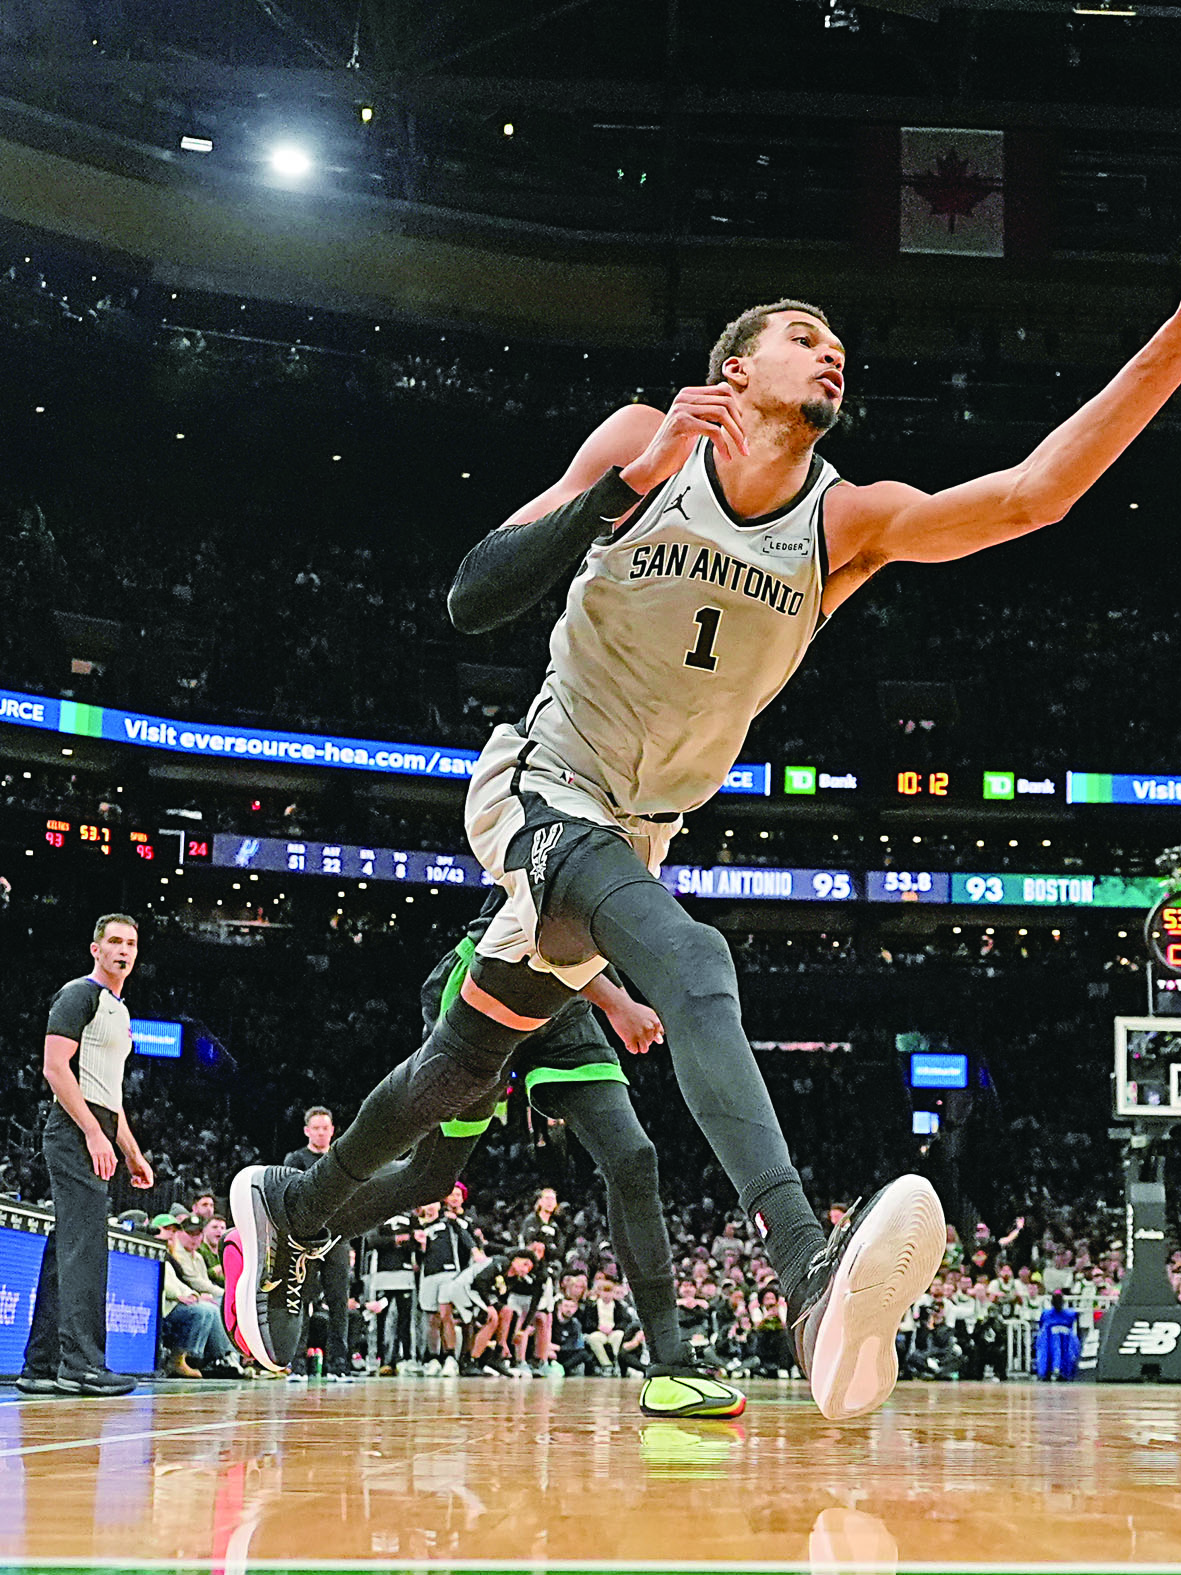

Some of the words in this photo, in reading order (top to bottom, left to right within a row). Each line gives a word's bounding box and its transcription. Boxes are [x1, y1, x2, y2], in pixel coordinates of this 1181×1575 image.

[769, 540, 804, 552] LEDGER
[629, 543, 690, 580] SAN
[688, 546, 805, 617] ANTONIO
[683, 605, 723, 673] 1
[124, 718, 177, 746] Visit
[179, 731, 479, 775] eversource-hea.com/sav
[722, 771, 753, 788] CE
[789, 771, 813, 789] TD
[819, 773, 857, 789] Bank
[897, 771, 949, 796] 10:12
[987, 775, 1011, 795] TD
[1017, 778, 1055, 794] Bank
[45, 832, 65, 848] 93
[188, 841, 208, 857] 24
[136, 845, 154, 860] 95
[288, 855, 304, 870] 51
[322, 858, 341, 873] 22
[362, 861, 373, 876] 4
[396, 864, 406, 878] 8
[426, 866, 464, 883] 10/43
[677, 868, 714, 894] SAN
[717, 869, 792, 896] ANTONIO
[812, 872, 850, 899] 95
[884, 871, 932, 892] 53.8
[965, 876, 1004, 902] 93
[1023, 877, 1095, 903] BOSTON
